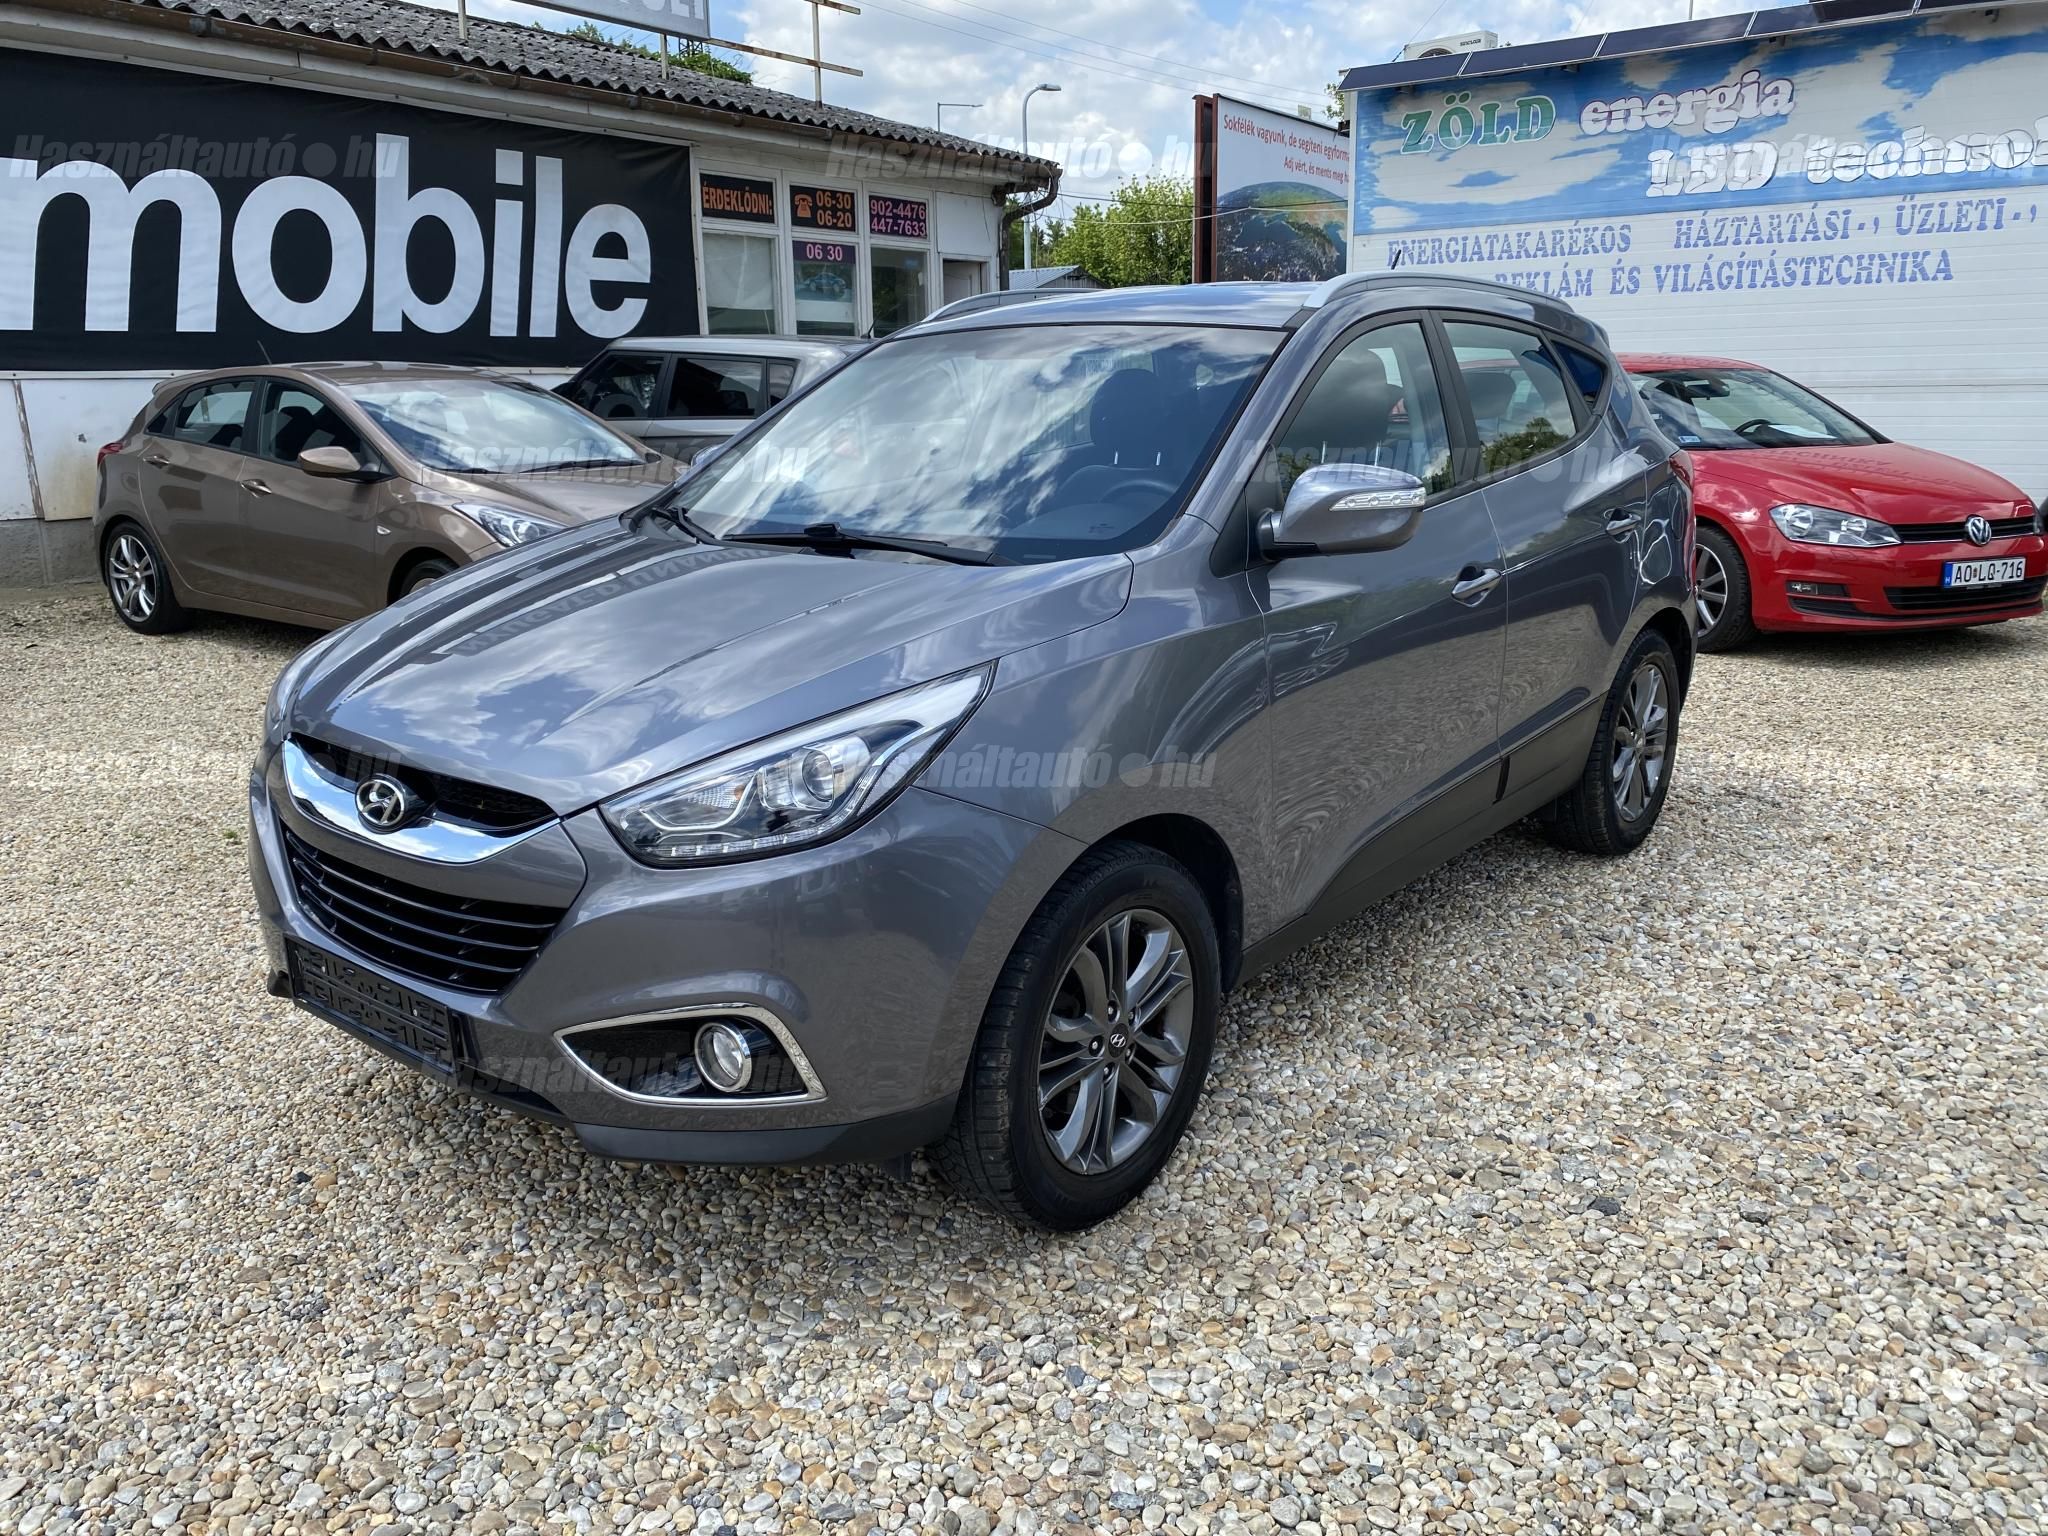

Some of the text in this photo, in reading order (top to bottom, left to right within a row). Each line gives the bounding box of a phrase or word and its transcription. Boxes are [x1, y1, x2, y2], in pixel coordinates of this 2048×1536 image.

[1399, 70, 1796, 156] ZÖLD energia
[1223, 114, 1255, 137] Sokfélék
[1288, 131, 1297, 148] de
[816, 190, 851, 210] 06-30
[870, 199, 926, 220] 902-4476
[816, 209, 852, 228] 06-20
[871, 217, 927, 236] 447-7633
[0, 133, 652, 338] mobile
[1387, 220, 1632, 267] ENERGIATAKARÉKOS
[806, 243, 843, 262] 06 30
[1610, 258, 1641, 295] ÉS
[1653, 249, 1955, 294] VILÁGÍTÁSTECHNIKA
